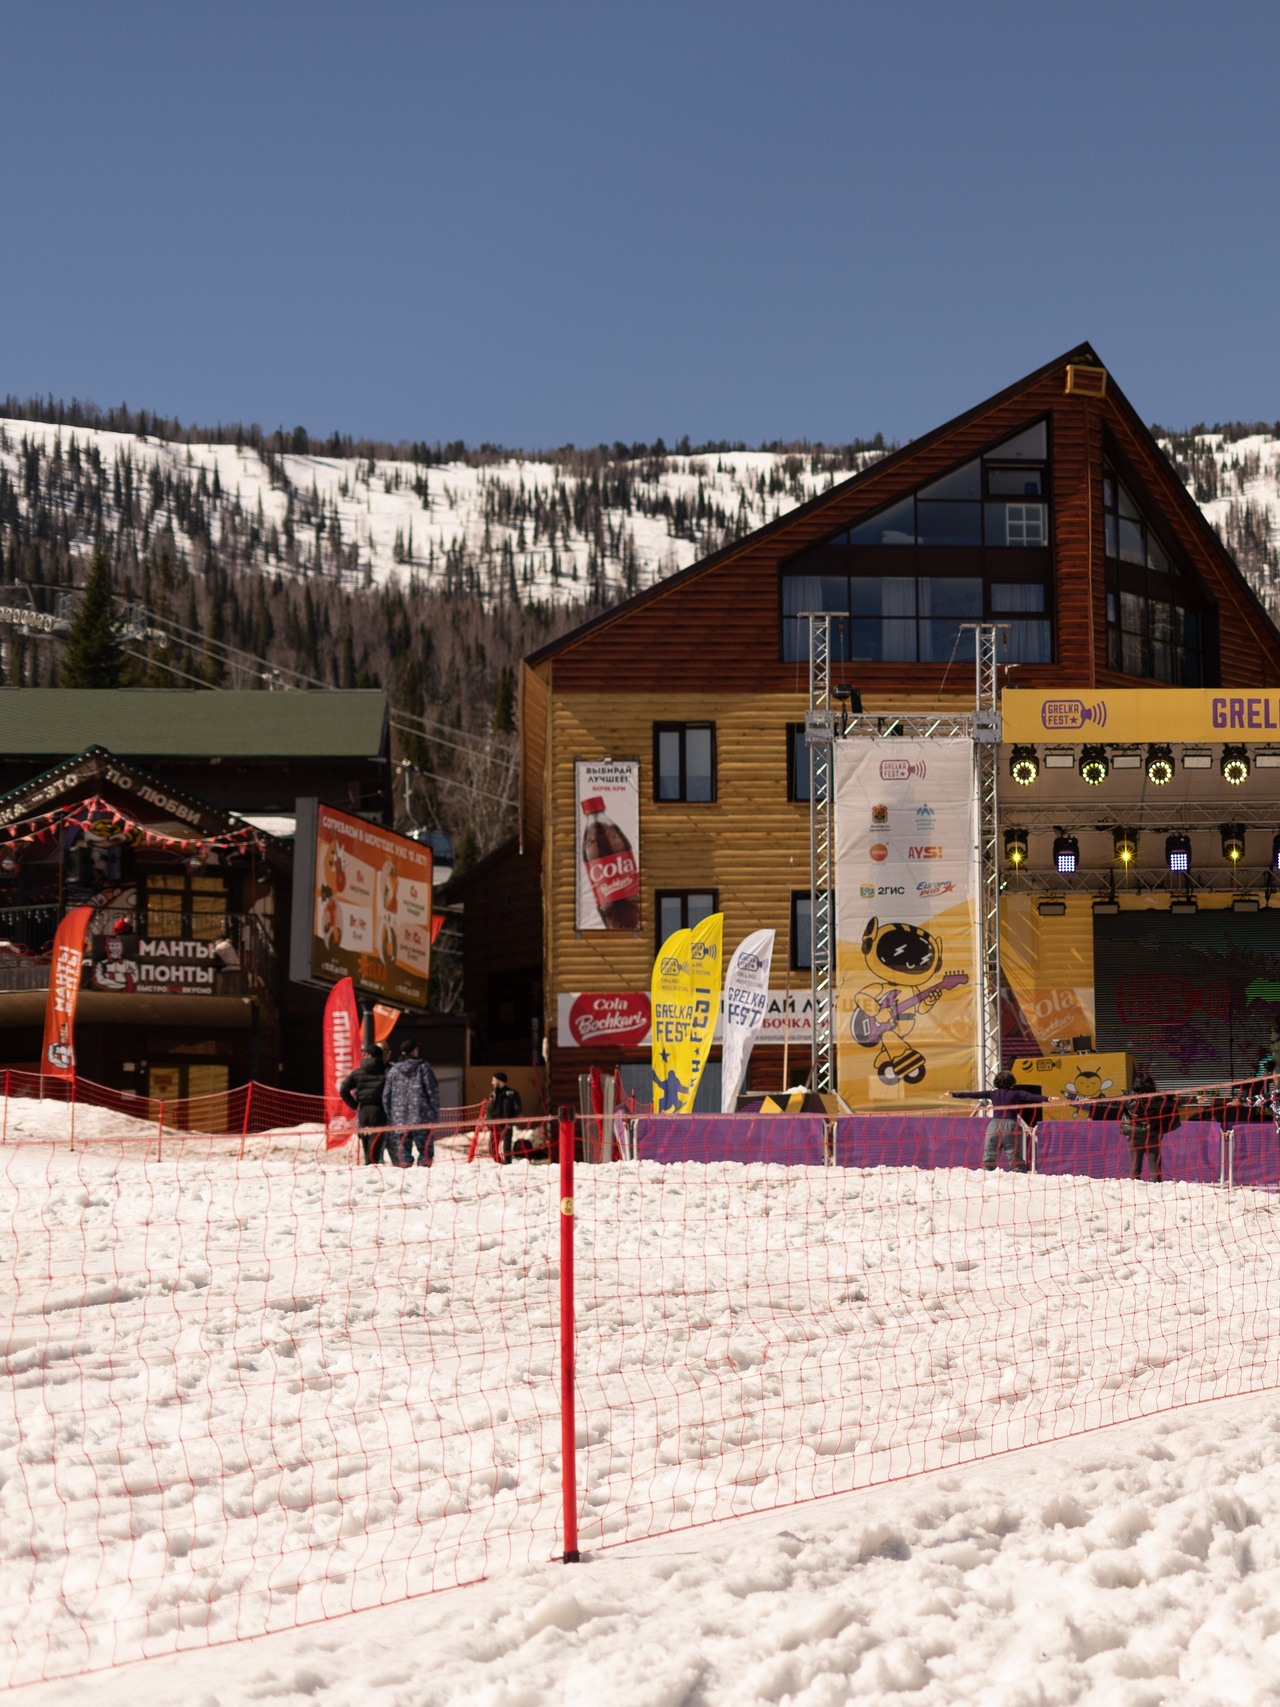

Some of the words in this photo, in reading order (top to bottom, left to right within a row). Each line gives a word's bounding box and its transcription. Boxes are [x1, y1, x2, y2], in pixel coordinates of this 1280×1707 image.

[1048, 704, 1079, 714] GRELKA
[1048, 715, 1069, 725] FEST
[586, 765, 632, 774] ВЫБИРАЙ
[884, 770, 899, 778] FEST
[104, 768, 133, 790] ПО
[137, 785, 201, 826] ЛЮБВИ
[908, 846, 943, 859] AYS!
[589, 856, 634, 883] Cola
[878, 887, 905, 895] 2ГИС
[139, 939, 216, 959] МАНТЫ
[54, 945, 70, 1012] МАНТЫ
[140, 964, 214, 984] ПОНТЫ
[593, 999, 628, 1011] Cola
[655, 1003, 693, 1020] GRELKA
[575, 1011, 648, 1038] Bochkari
[656, 1020, 691, 1043] FEST
